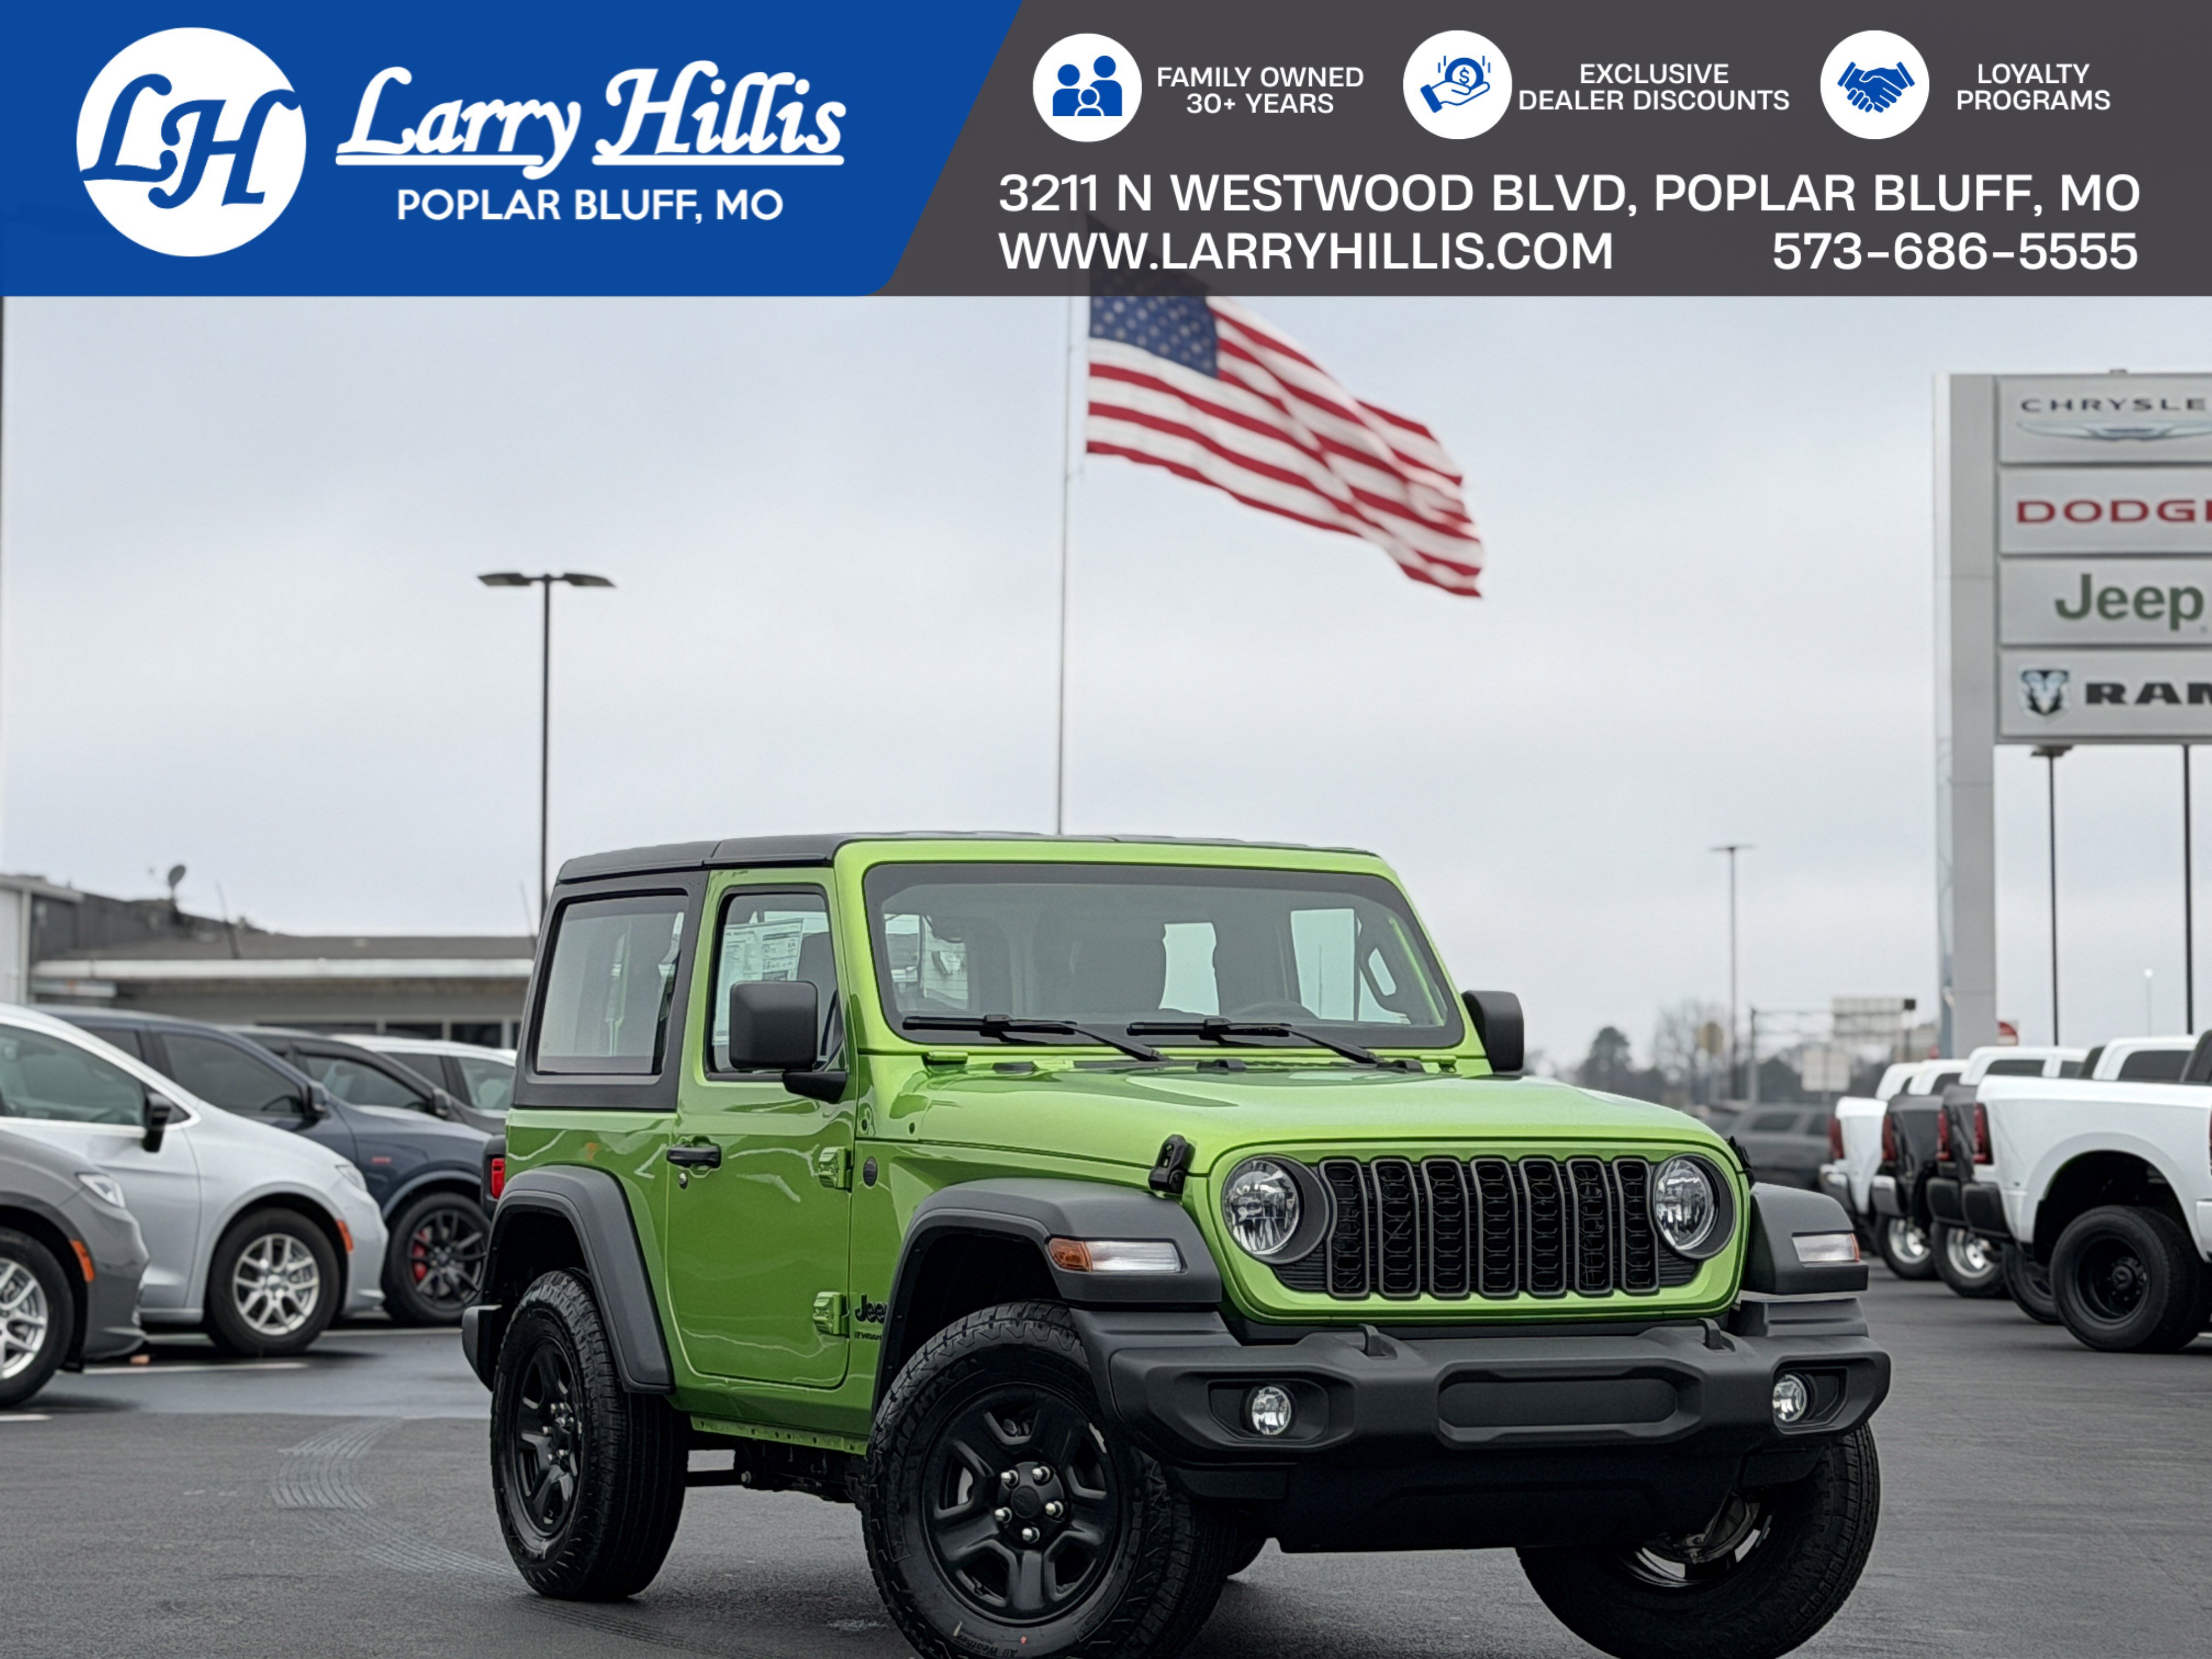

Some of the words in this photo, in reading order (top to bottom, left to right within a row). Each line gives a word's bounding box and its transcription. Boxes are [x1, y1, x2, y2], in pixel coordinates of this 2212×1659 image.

[2017, 500, 2212, 523] DODG
[2055, 573, 2205, 631] Jeep
[855, 1294, 888, 1324] Jee
